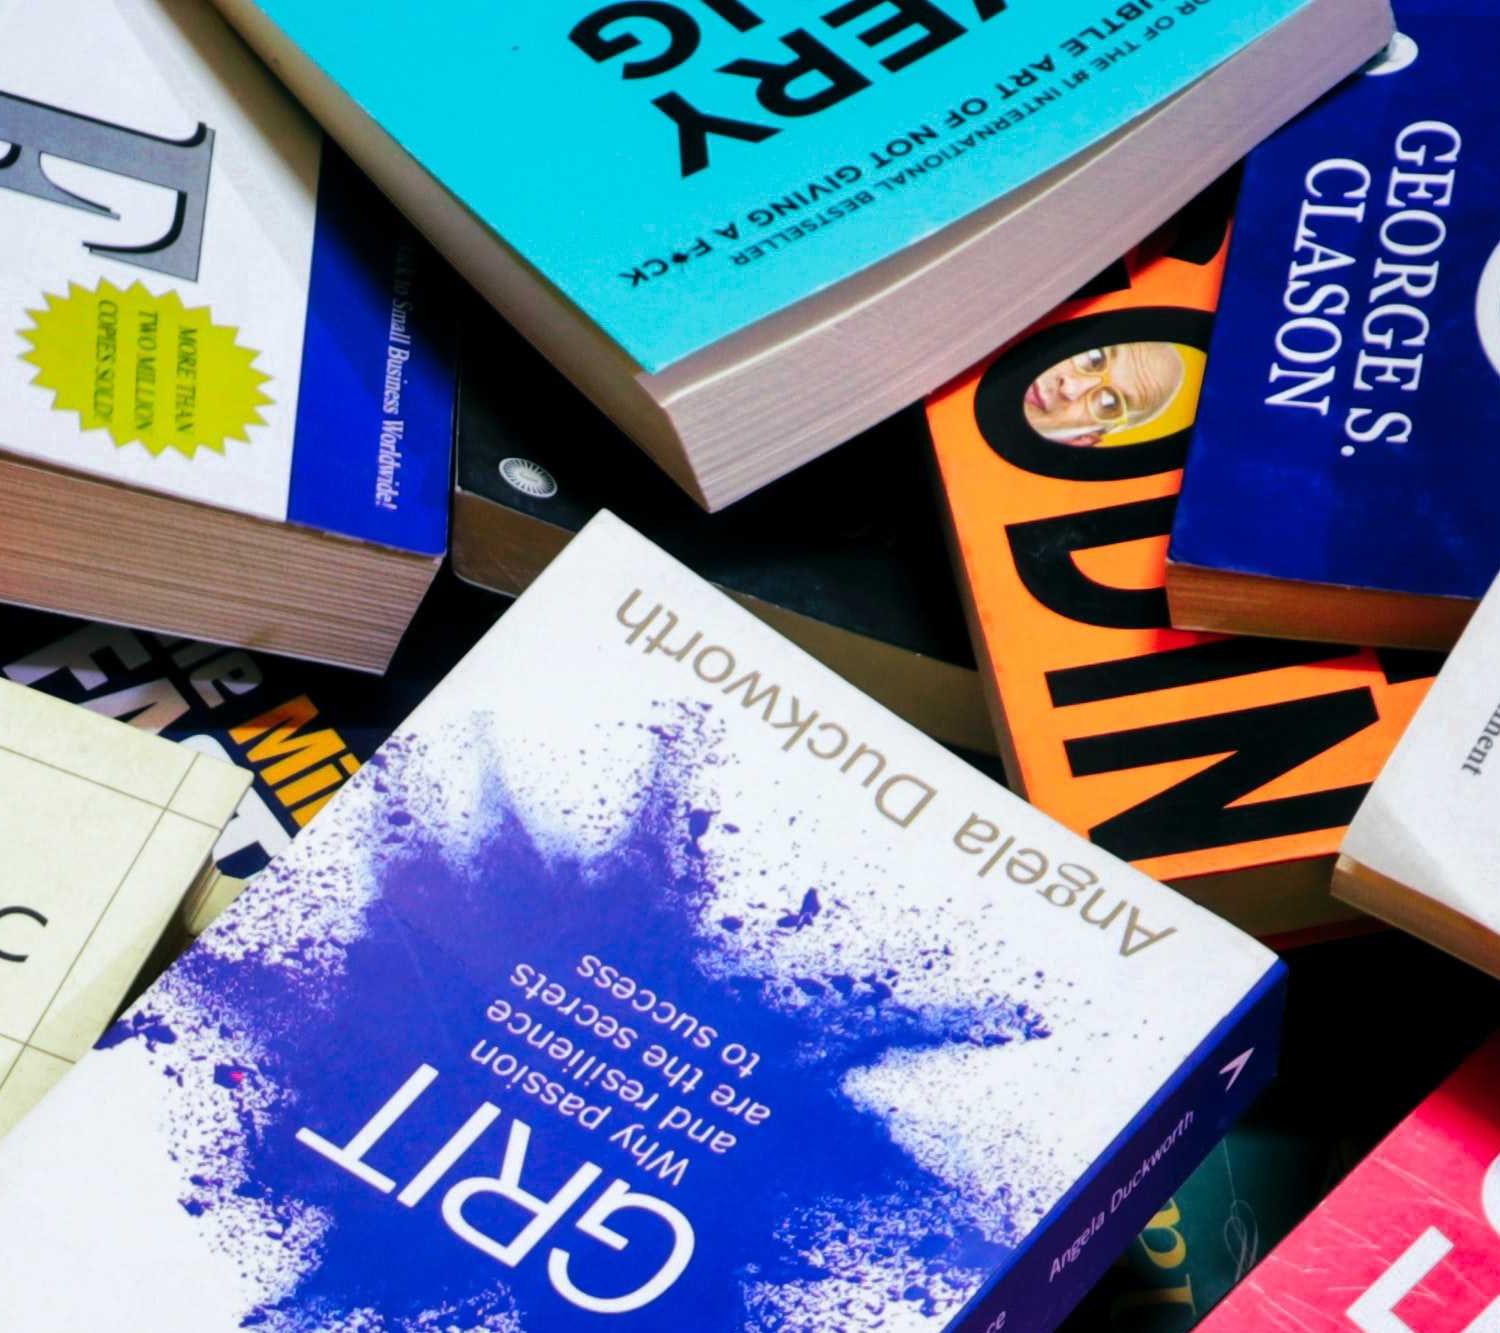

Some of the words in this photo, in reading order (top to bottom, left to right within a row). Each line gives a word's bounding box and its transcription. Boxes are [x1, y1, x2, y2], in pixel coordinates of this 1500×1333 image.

[1264, 158, 1371, 416] CLASON
[1354, 120, 1462, 393] GEORGE
[1342, 410, 1414, 459] S.
[616, 586, 938, 830] Duckworth
[954, 809, 1177, 960] Angela
[510, 963, 638, 1049] secrets
[576, 954, 718, 1048] success
[469, 1038, 612, 1129] passion
[485, 999, 659, 1111] resilience
[641, 1044, 703, 1090] the
[720, 1042, 760, 1076] to
[661, 1105, 741, 1164] and
[709, 1083, 771, 1125] are
[297, 1062, 696, 1315] GRIT
[609, 1123, 689, 1181] Why
